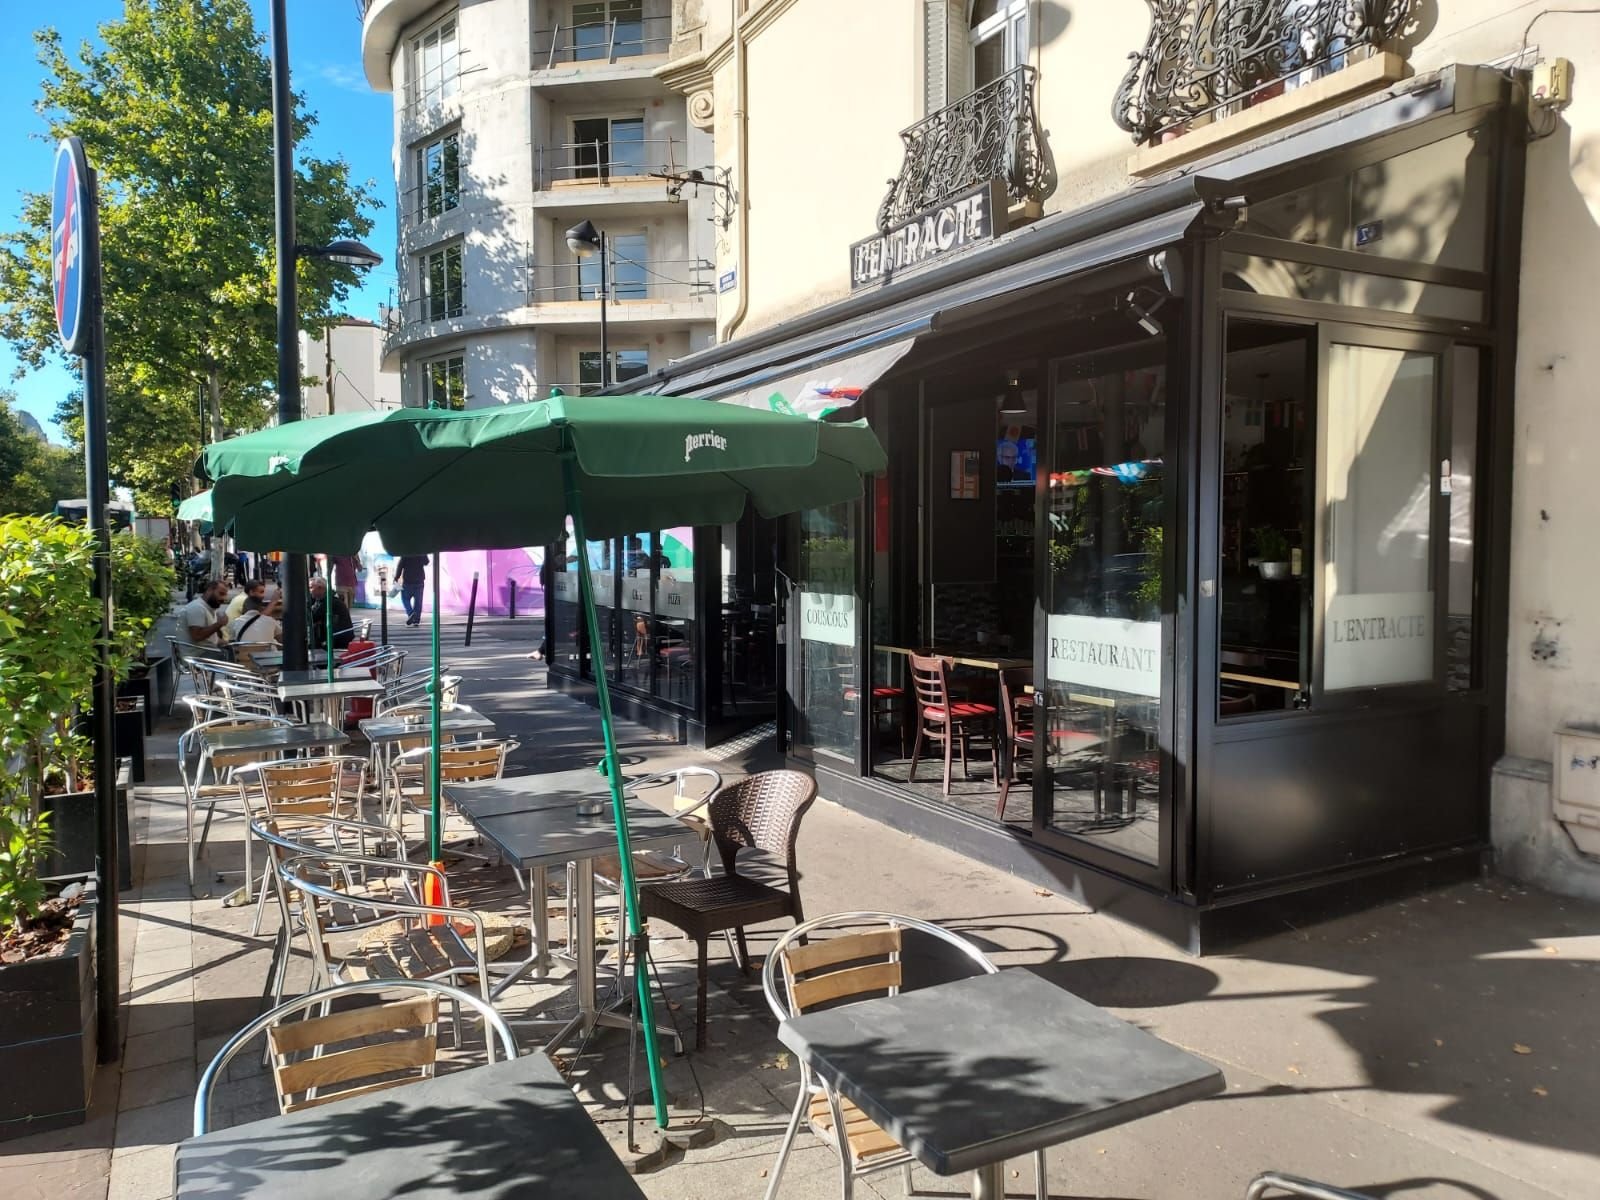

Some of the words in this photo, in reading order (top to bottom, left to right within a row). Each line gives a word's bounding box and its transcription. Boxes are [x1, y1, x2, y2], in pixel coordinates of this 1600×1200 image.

[854, 193, 983, 281] L'ENTRACTE
[806, 608, 849, 629] COUSCOUS
[1333, 615, 1425, 643] L'ENTRACTE
[1051, 637, 1156, 673] RESTAURANT
